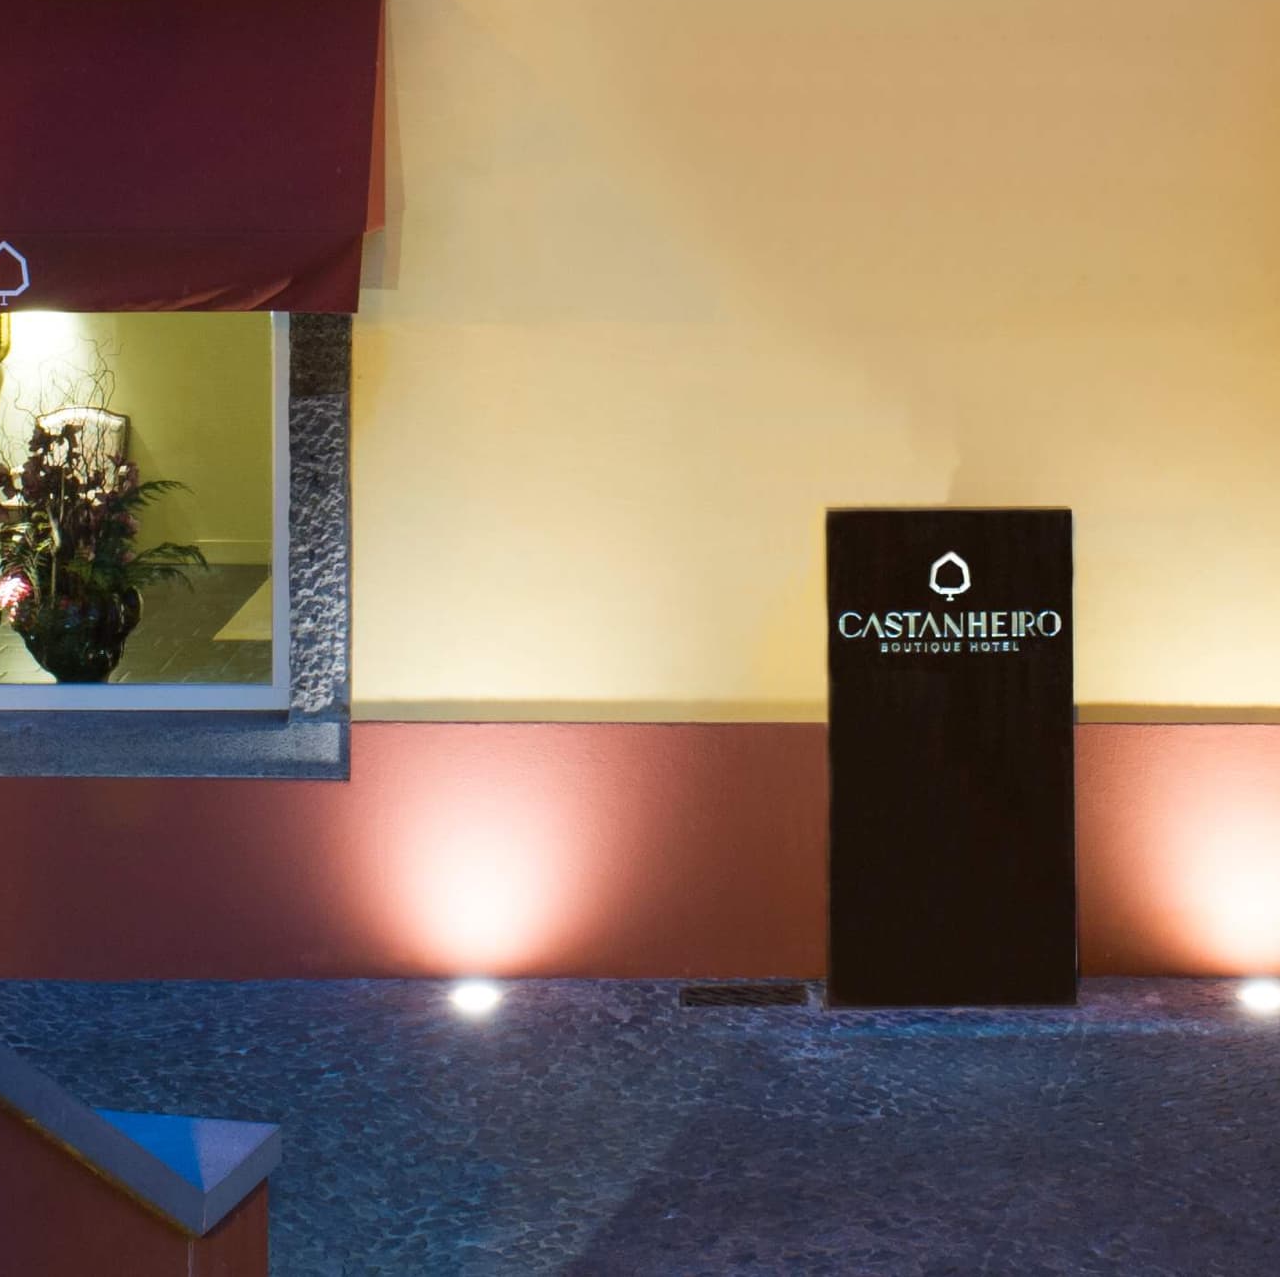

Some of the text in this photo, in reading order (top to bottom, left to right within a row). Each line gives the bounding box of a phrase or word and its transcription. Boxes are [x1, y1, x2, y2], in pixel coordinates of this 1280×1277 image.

[838, 611, 1062, 638] CASTANHEIRO
[880, 641, 1020, 654] BOUTIQUE HOTEL
